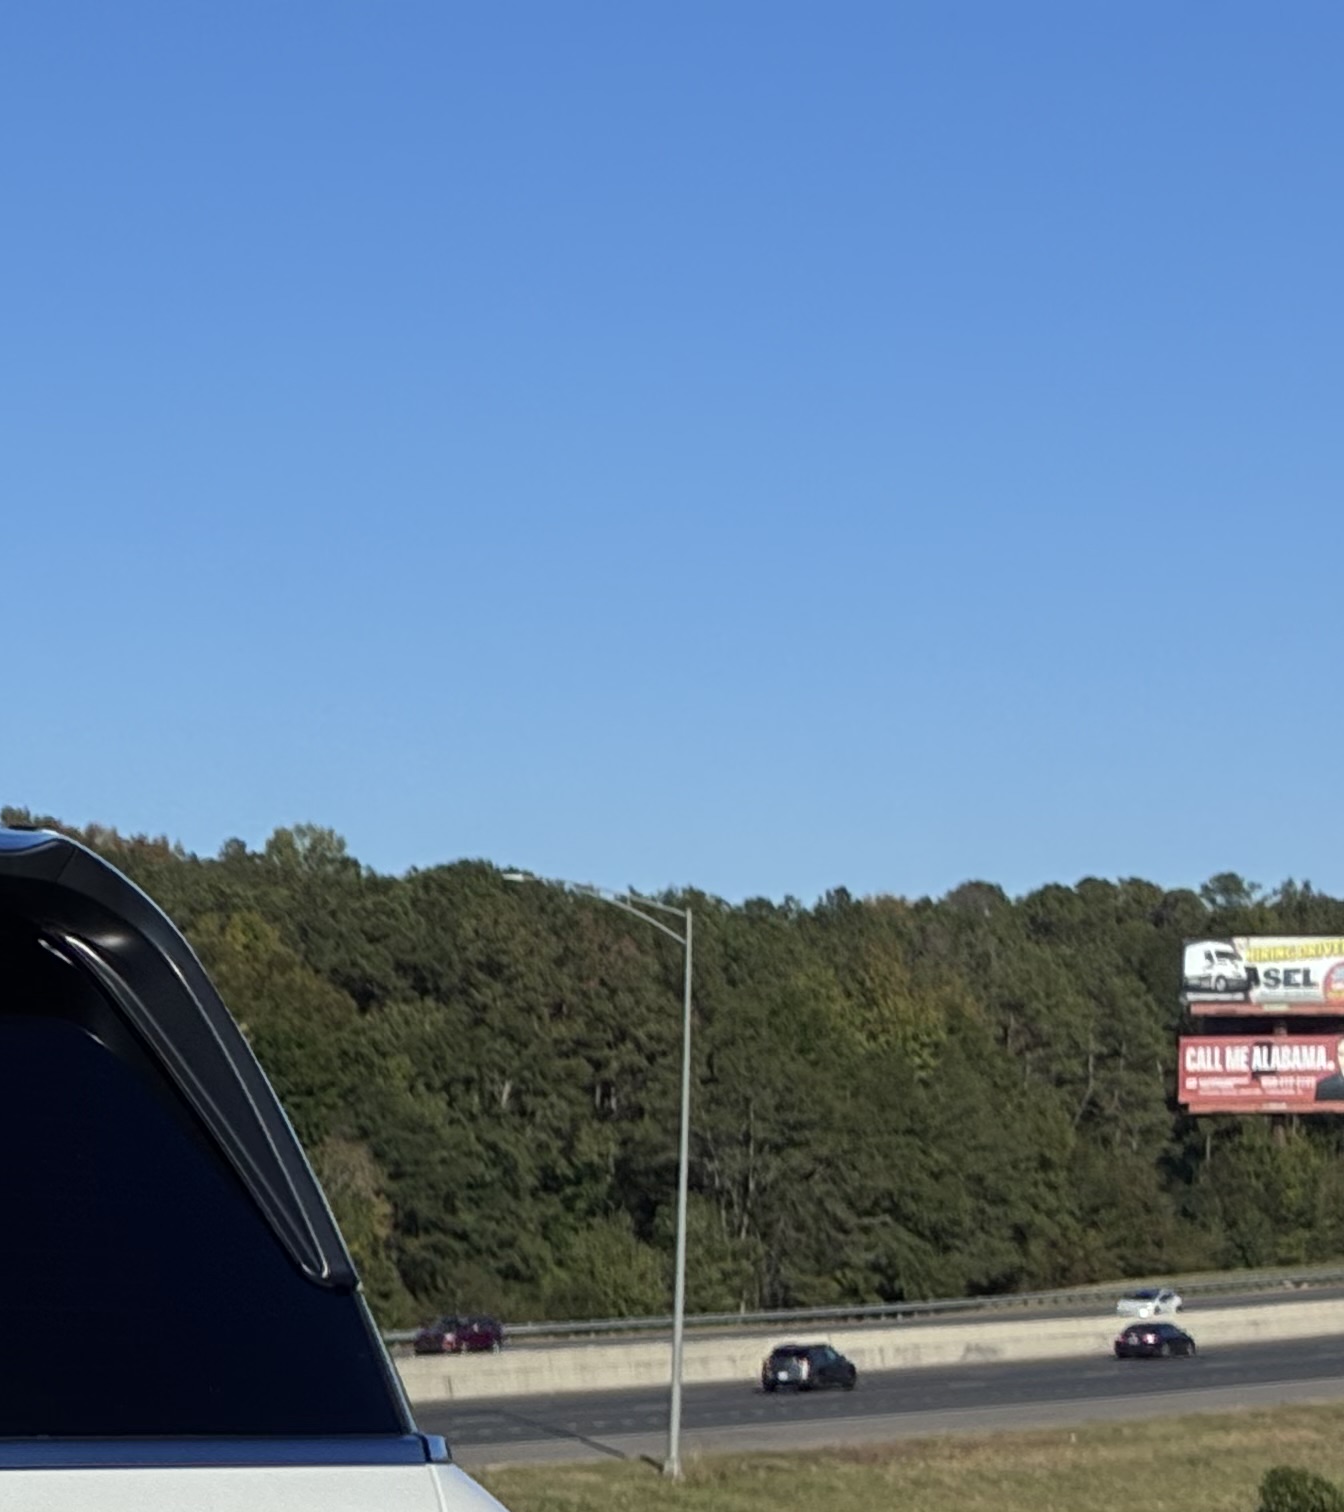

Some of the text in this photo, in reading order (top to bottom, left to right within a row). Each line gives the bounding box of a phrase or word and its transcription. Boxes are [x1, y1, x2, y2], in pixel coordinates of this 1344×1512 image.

[1298, 940, 1344, 957] DRIVE
[1185, 1045, 1223, 1072] CALL
[1225, 1045, 1250, 1072] ME
